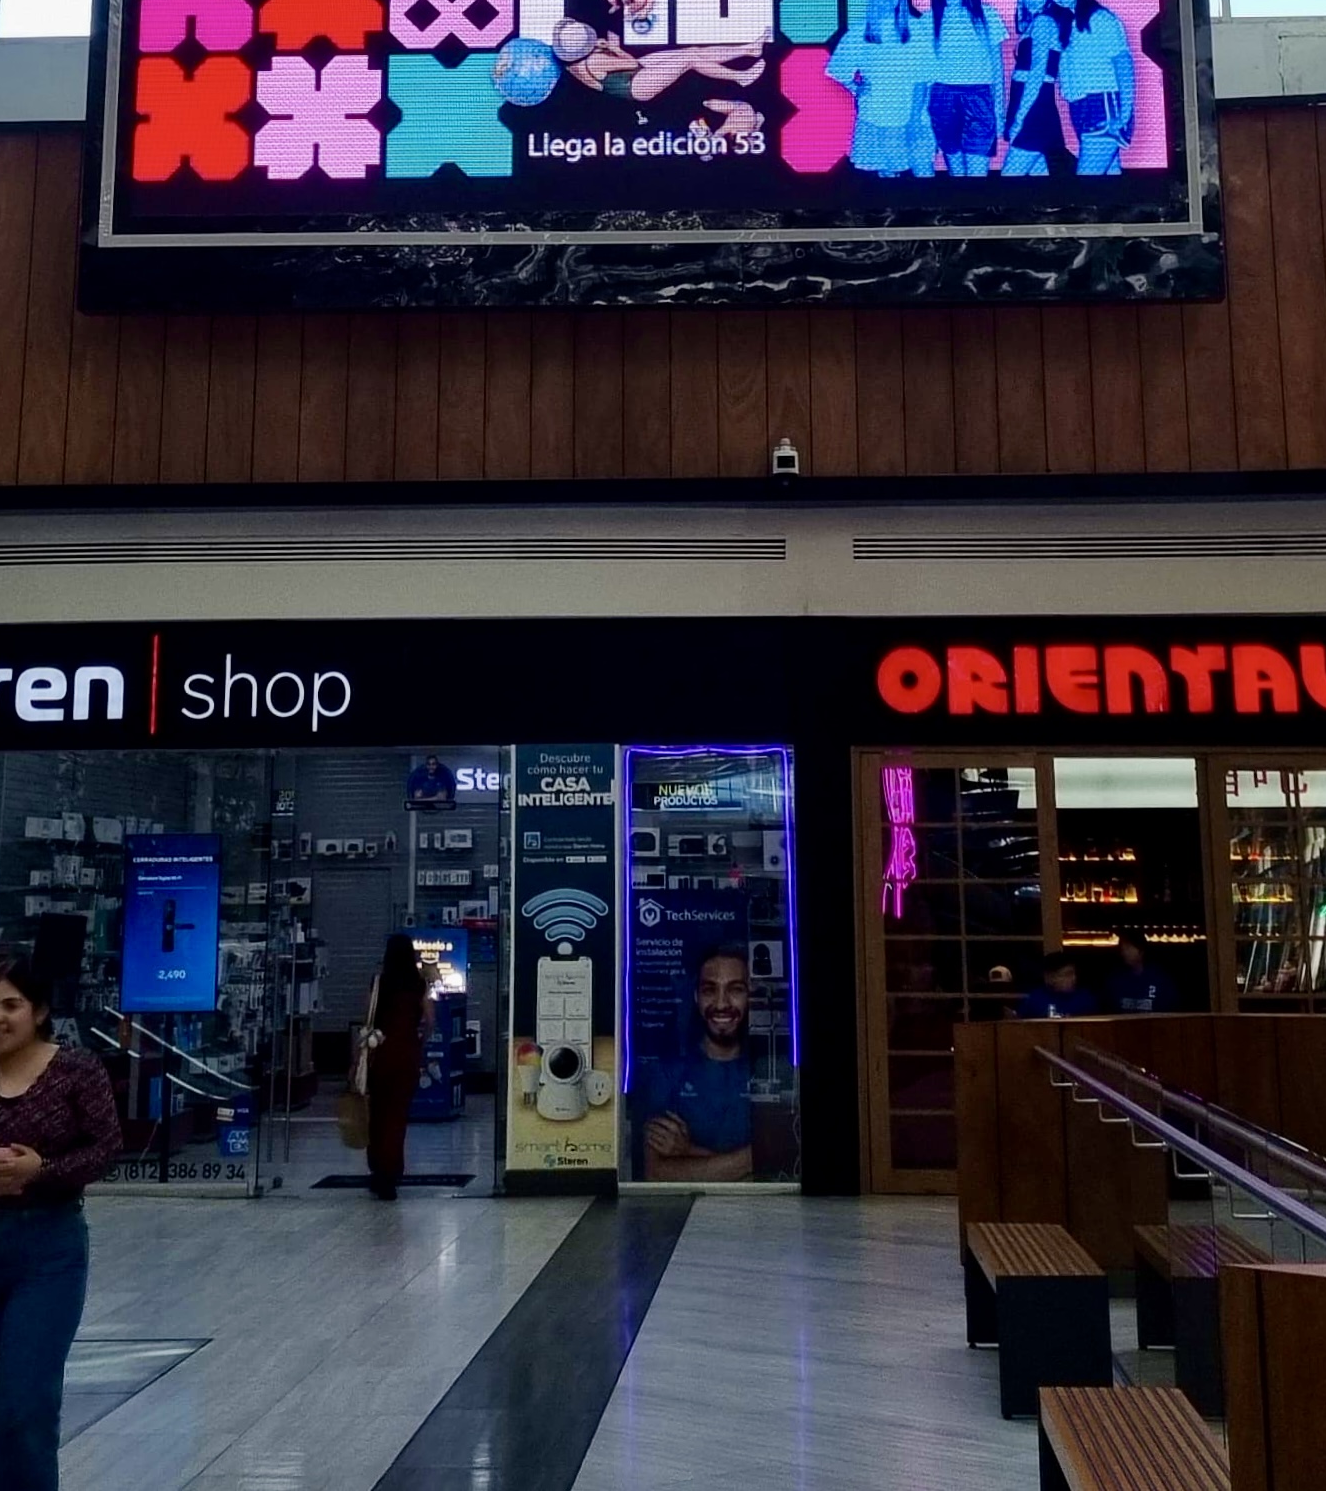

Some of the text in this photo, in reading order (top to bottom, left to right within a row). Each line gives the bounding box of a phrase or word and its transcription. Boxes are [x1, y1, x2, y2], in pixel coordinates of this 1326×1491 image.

[528, 133, 597, 162] Llega
[604, 132, 626, 156] la
[733, 131, 766, 155] 53
[181, 653, 351, 731] shop
[540, 753, 591, 764] Descubre
[559, 764, 589, 775] hacer
[593, 765, 604, 775] tu
[540, 776, 591, 792] CASA
[658, 784, 713, 796] NUEVOS
[518, 793, 613, 807] INTELIGENTE
[653, 796, 718, 806] PRODUCTOS
[665, 910, 736, 922] TechServices
[557, 1156, 588, 1166] Steren
[169, 1163, 197, 1179] 386
[202, 1163, 221, 1179] 89
[226, 1164, 245, 1180] 34
